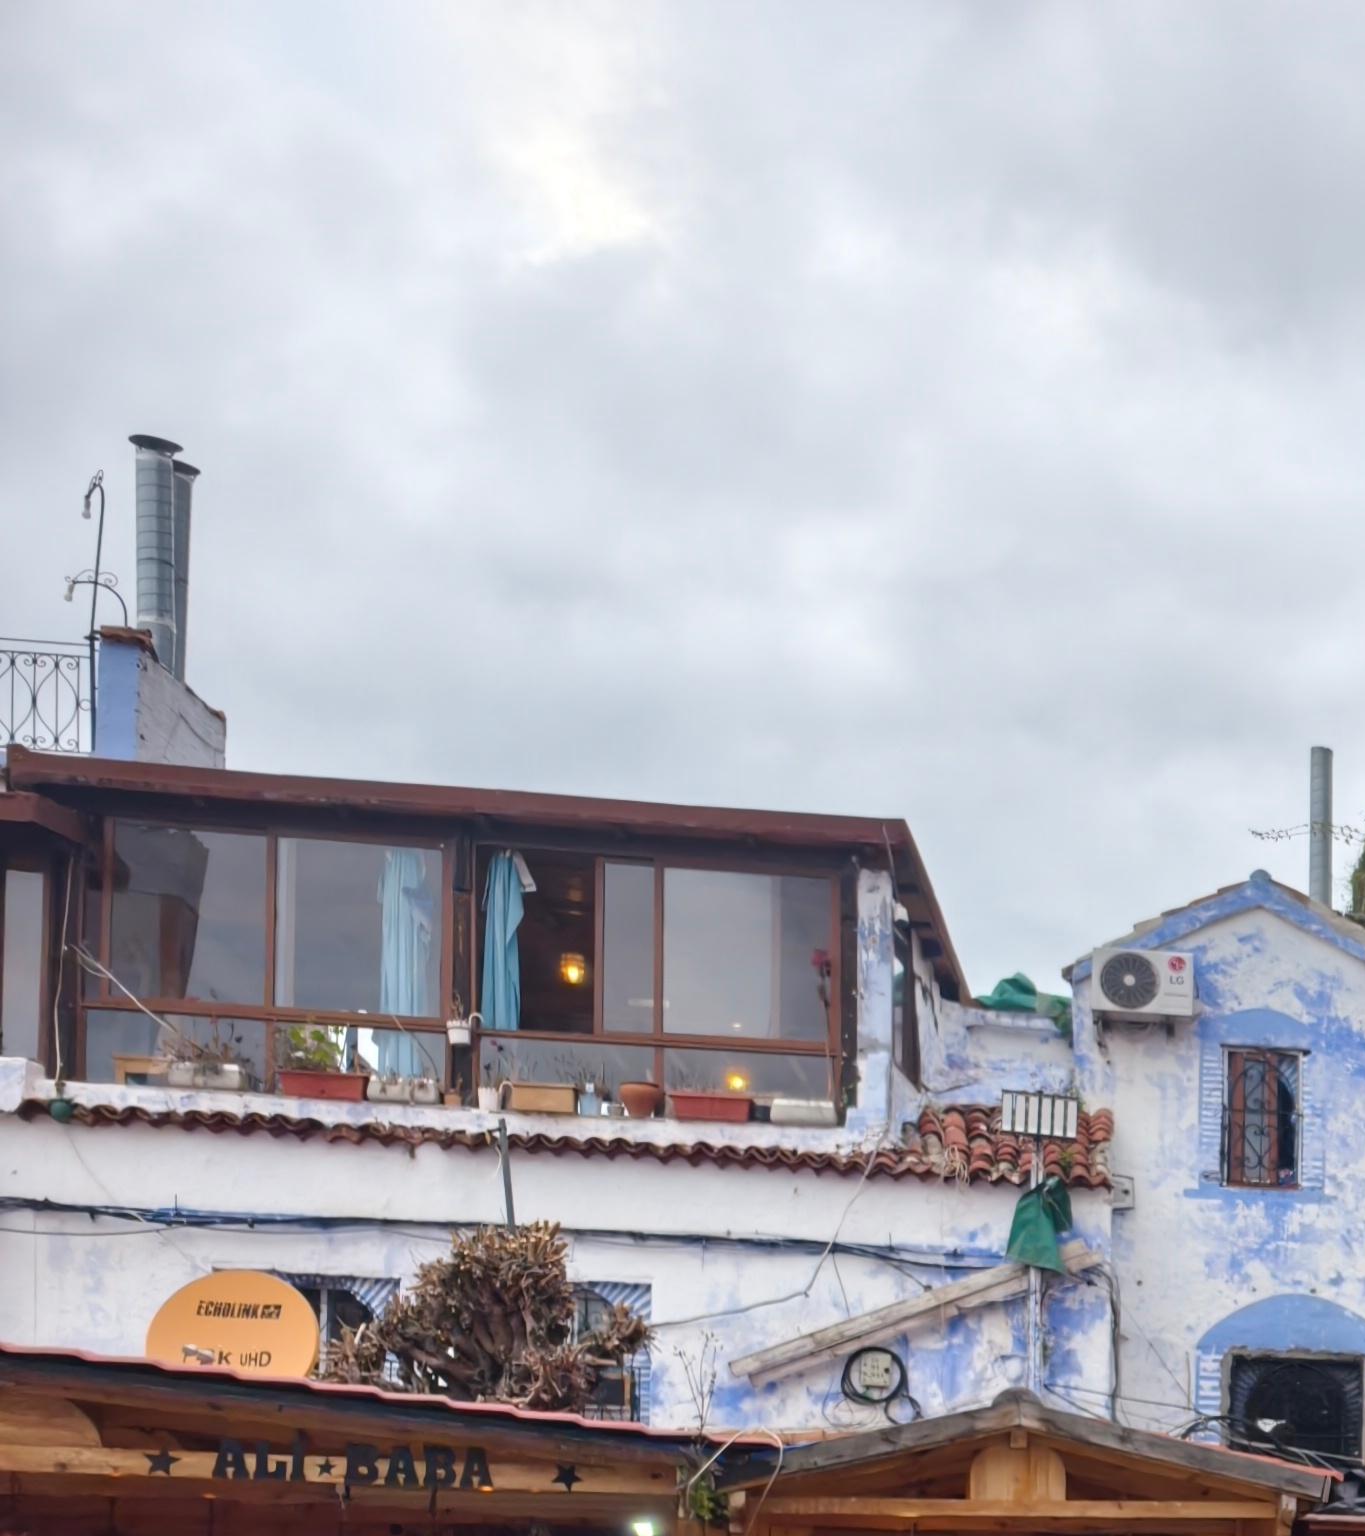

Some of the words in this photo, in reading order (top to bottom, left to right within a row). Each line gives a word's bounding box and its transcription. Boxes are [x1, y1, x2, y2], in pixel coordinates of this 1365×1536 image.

[1169, 975, 1185, 985] LG
[196, 1300, 259, 1319] ECHOLINK
[239, 1351, 272, 1367] UHD
[347, 1442, 494, 1489] BABA
